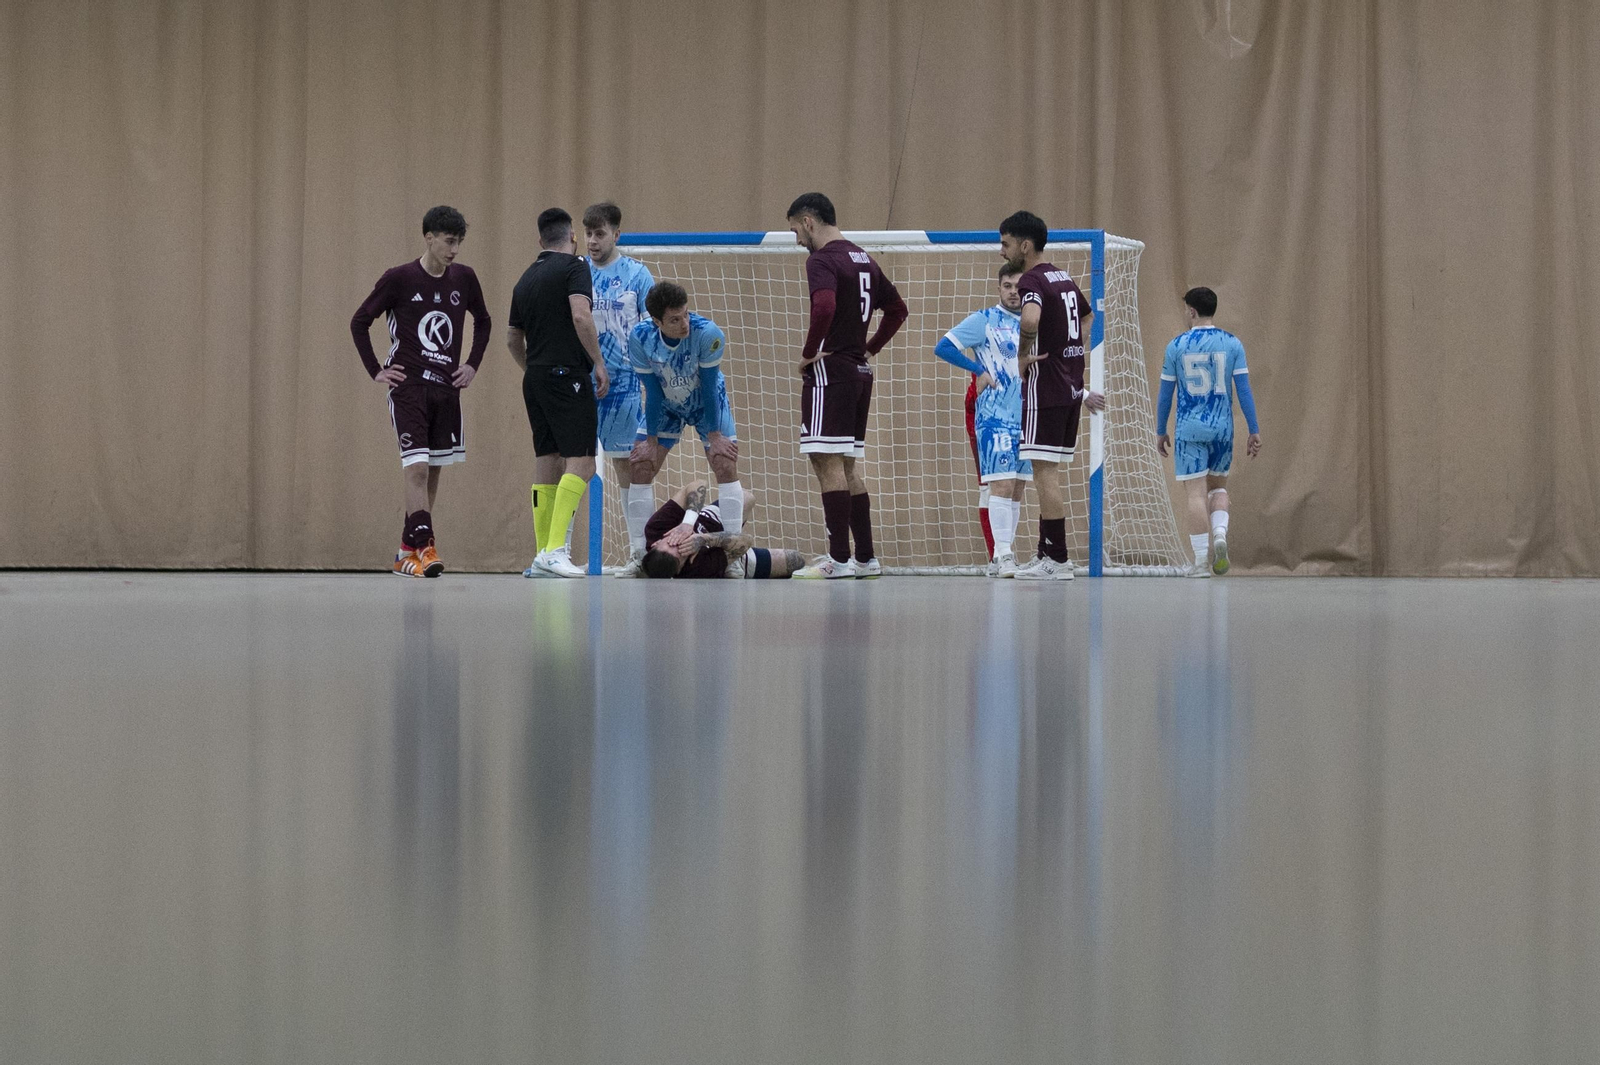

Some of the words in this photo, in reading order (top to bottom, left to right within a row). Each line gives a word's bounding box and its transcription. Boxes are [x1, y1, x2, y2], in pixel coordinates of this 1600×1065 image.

[859, 272, 871, 323] 5
[1061, 291, 1079, 341] 13
[1182, 352, 1226, 397] 51
